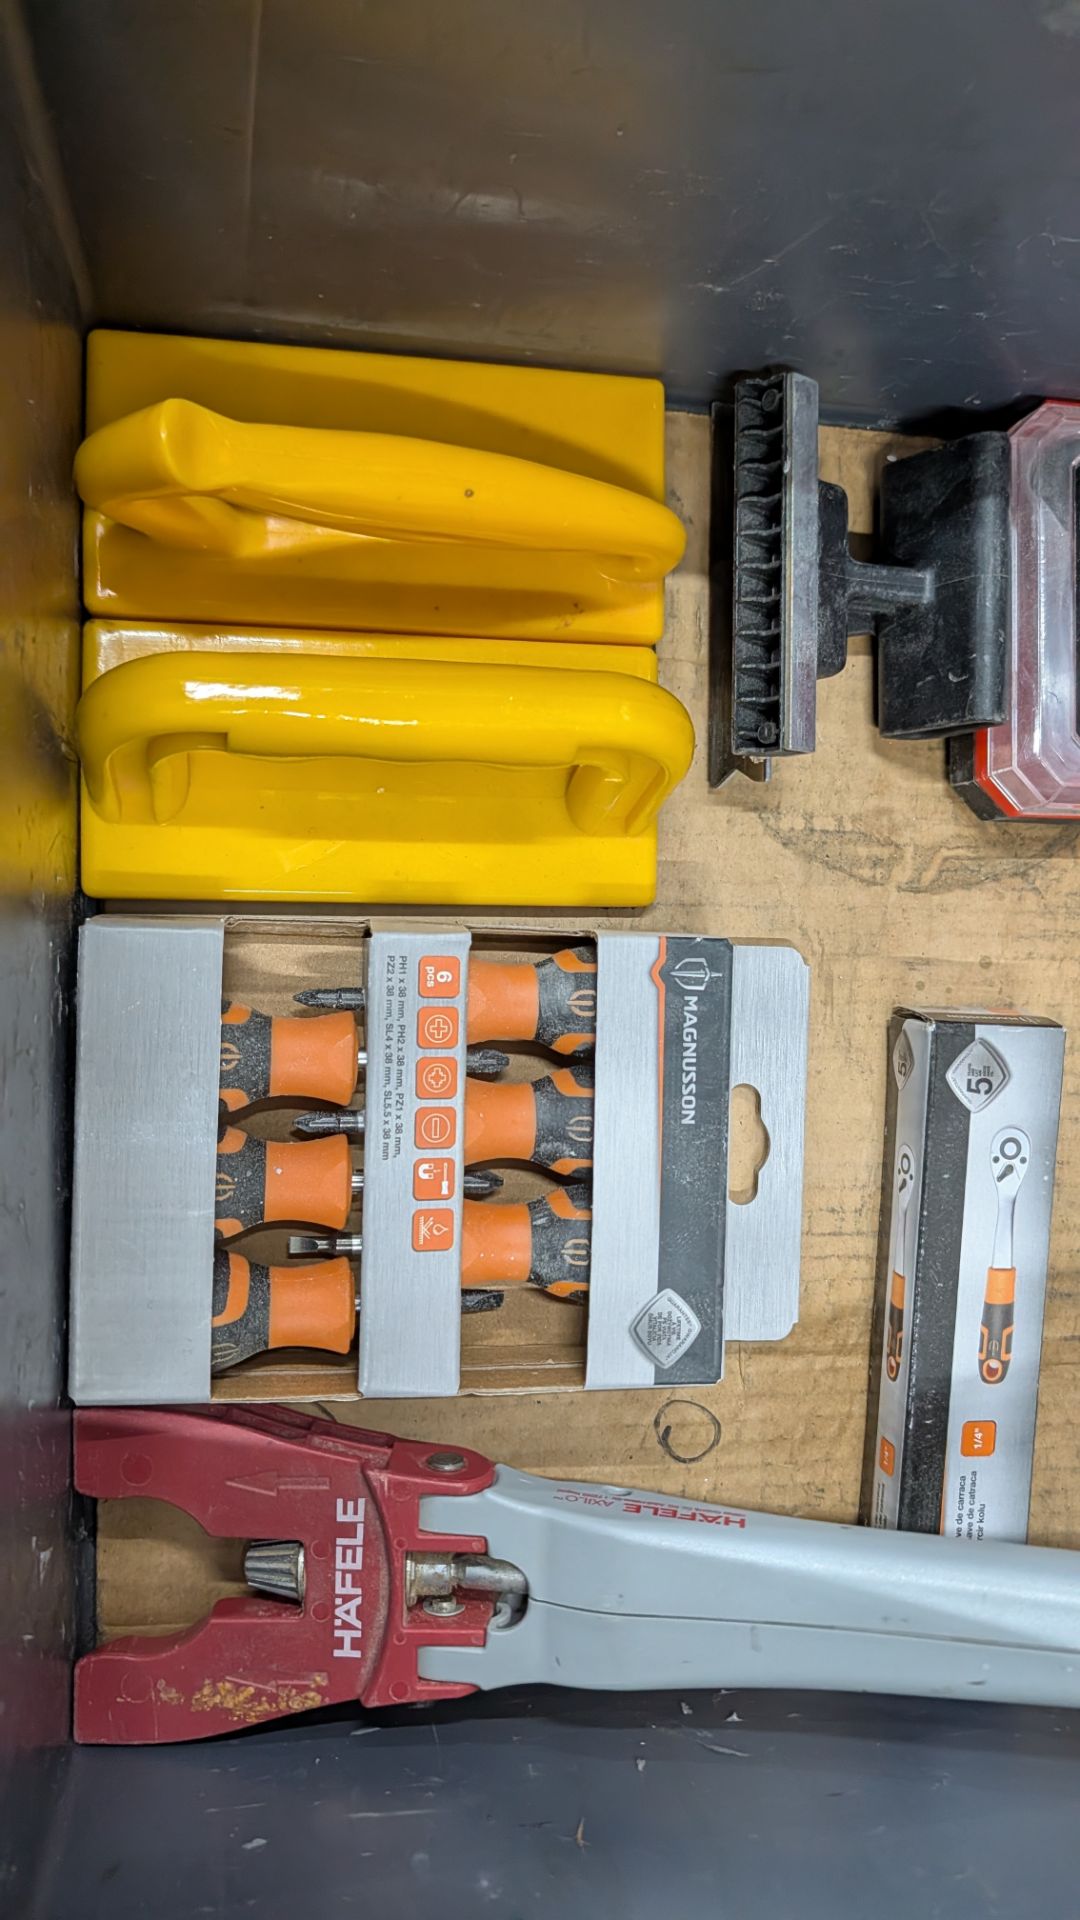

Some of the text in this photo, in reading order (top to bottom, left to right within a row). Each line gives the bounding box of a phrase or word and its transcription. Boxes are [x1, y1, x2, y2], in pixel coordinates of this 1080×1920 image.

[386, 955, 396, 975] PZ2
[398, 955, 408, 975] PH1
[424, 966, 435, 988] pcs
[436, 971, 452, 983] 6
[386, 985, 394, 996] 38
[398, 986, 407, 998] 38
[384, 1000, 393, 1020] mm,
[396, 1000, 405, 1022] mm,
[386, 1023, 394, 1041] SL4
[397, 1024, 406, 1044] PH2
[385, 1052, 393, 1064] 38
[396, 1054, 405, 1066] 38
[681, 996, 698, 1125] MAGNUSSON
[384, 1066, 392, 1088] mm,
[898, 1061, 906, 1077] 5
[395, 1069, 403, 1090] mm,
[967, 1078, 992, 1095] 5
[384, 1090, 392, 1117] SL5.5
[396, 1093, 404, 1112] PZ1
[383, 1128, 391, 1139] 38
[395, 1123, 404, 1134] 38
[382, 1142, 390, 1160] mm
[393, 1137, 402, 1158] mm,
[958, 1476, 966, 1511] carraca
[968, 1471, 977, 1506] catraca
[623, 1502, 746, 1528] HÄFELE
[955, 1513, 963, 1525] de
[966, 1508, 974, 1519] de
[977, 1503, 986, 1523] kolu
[333, 1498, 366, 1658] HÄFELE
